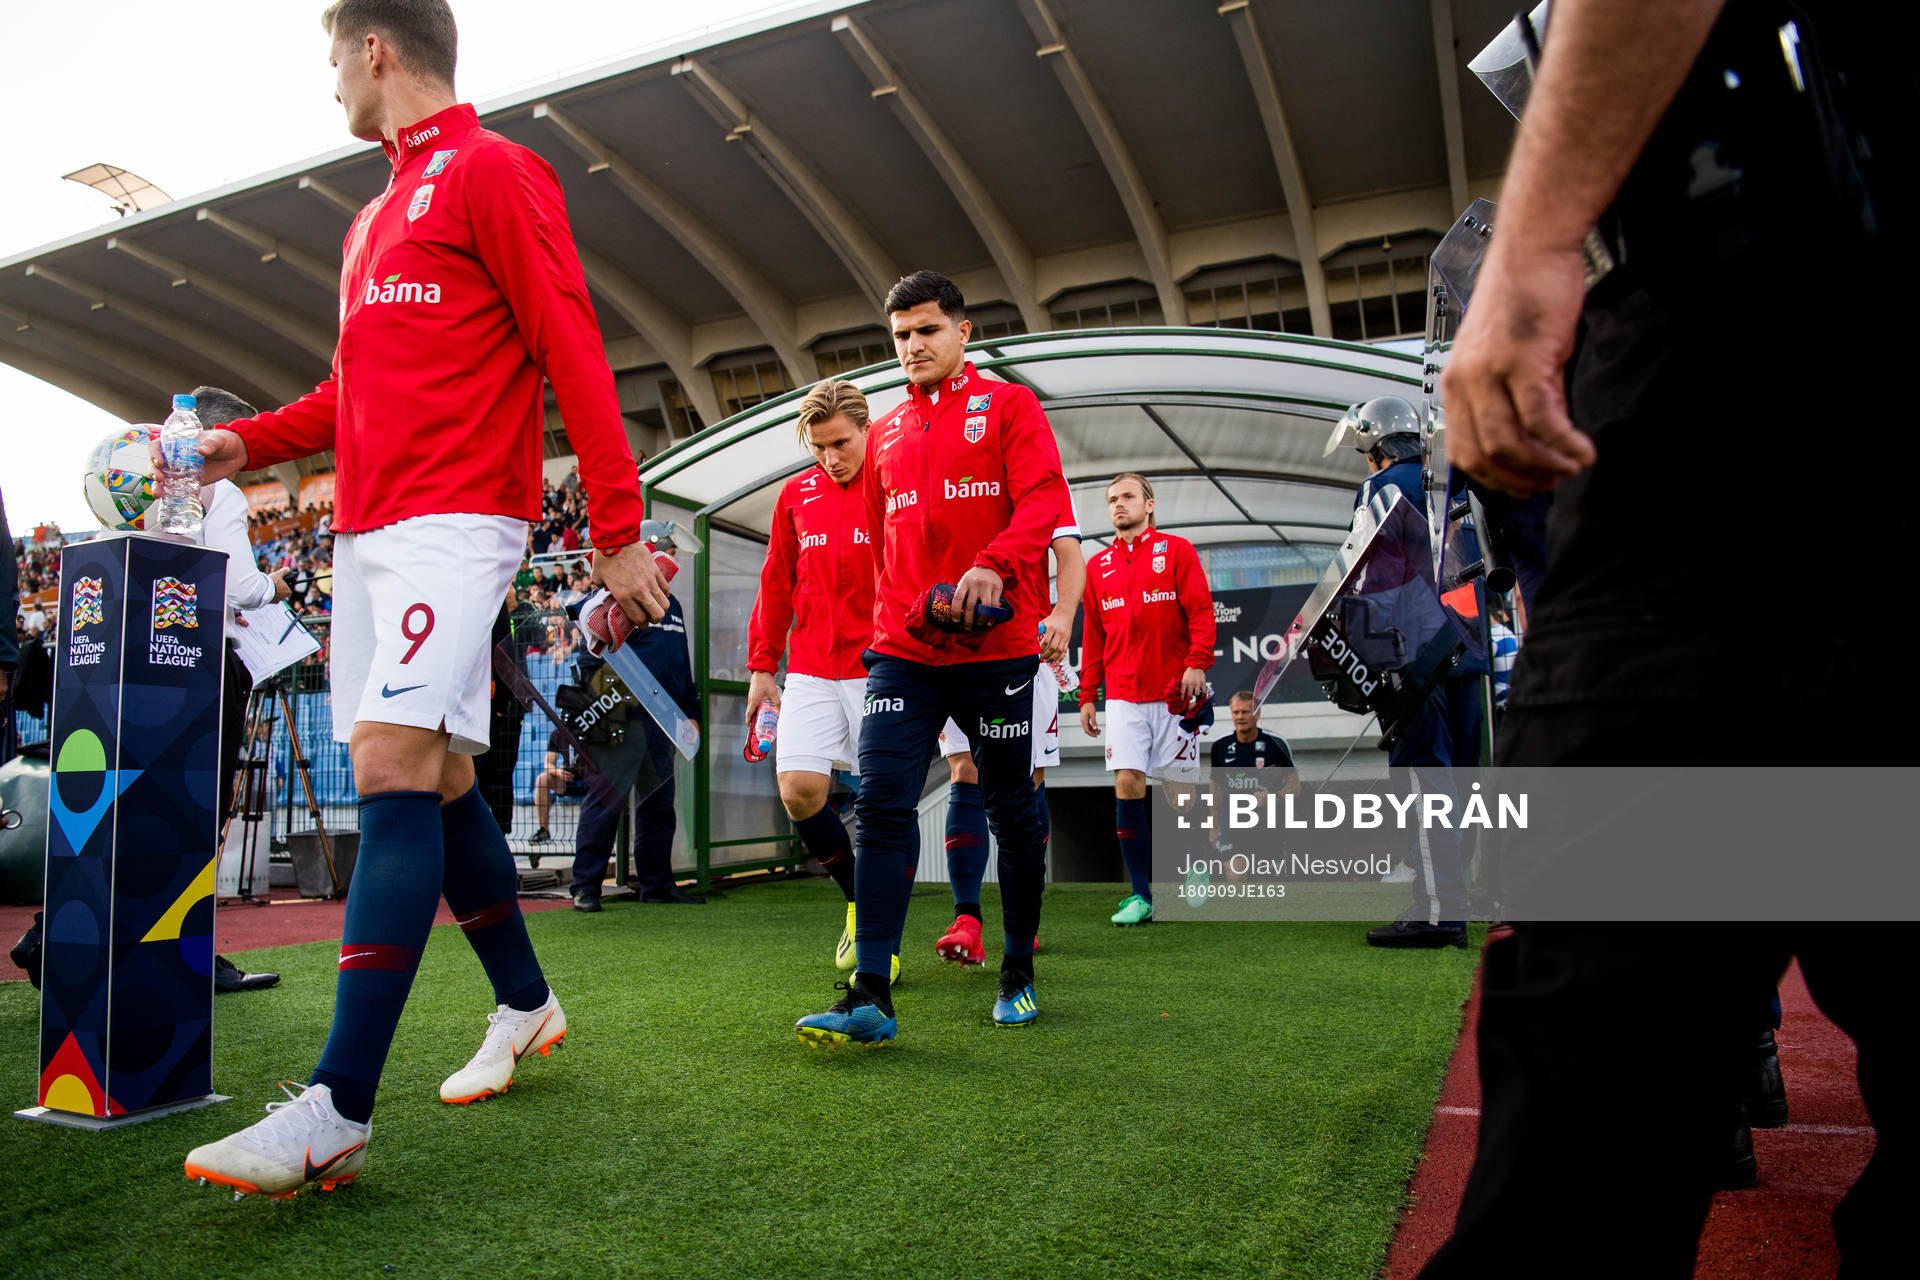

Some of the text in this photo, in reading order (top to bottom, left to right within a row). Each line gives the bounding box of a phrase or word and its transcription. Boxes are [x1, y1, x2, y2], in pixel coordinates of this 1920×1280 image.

[1214, 607, 1242, 617] TIONS
[74, 635, 90, 644] UEFA
[155, 634, 179, 645] UEFA
[400, 602, 435, 665] 9
[70, 642, 105, 656] NATIONS
[150, 643, 202, 658] NATIONS
[69, 653, 101, 667] LEAGUE
[149, 654, 196, 668] LEAGUE
[1321, 628, 1378, 697] POLICE
[575, 687, 622, 732] POLICE
[1174, 735, 1197, 761] 23
[1226, 773, 1259, 789] bam
